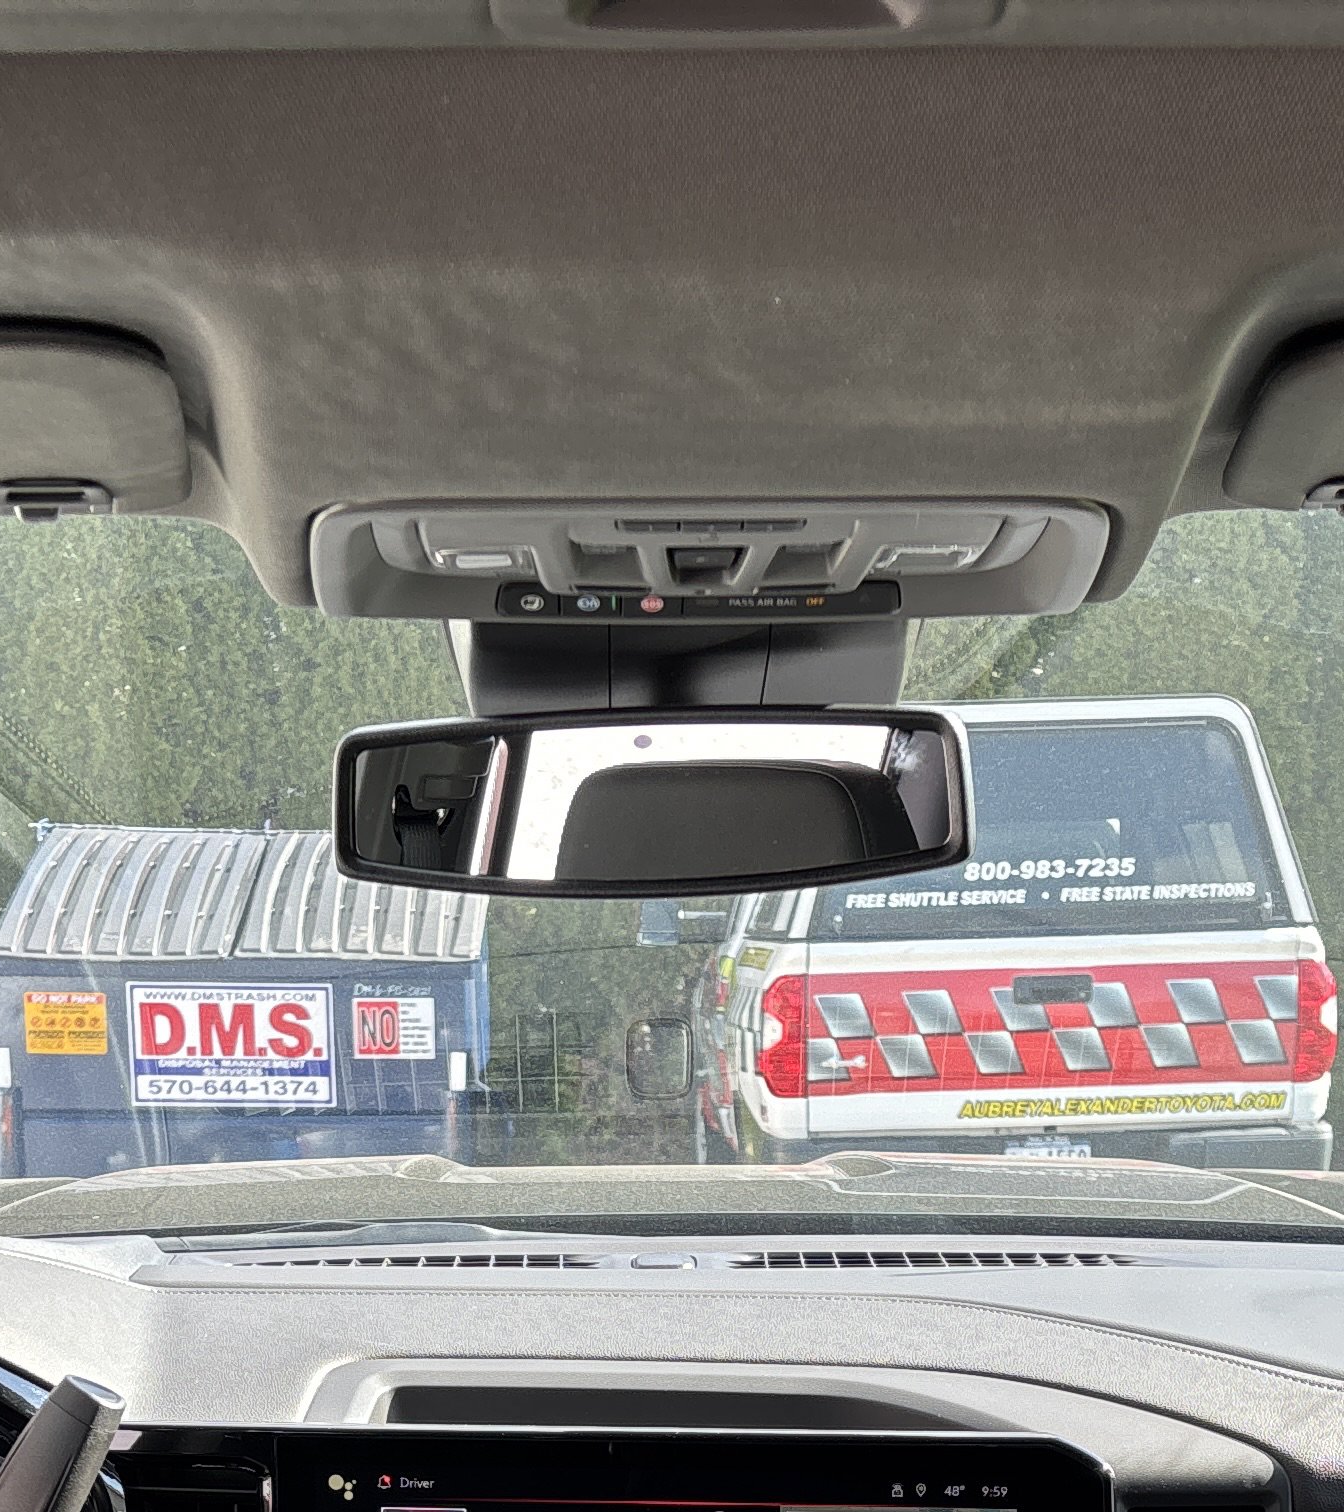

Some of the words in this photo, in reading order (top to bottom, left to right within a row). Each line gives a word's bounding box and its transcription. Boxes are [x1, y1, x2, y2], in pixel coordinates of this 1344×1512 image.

[963, 857, 1136, 881] 800-983-7235
[845, 893, 886, 908] FREE
[887, 891, 959, 907] SHUTTLE
[959, 889, 1027, 905] SERVICE
[1059, 887, 1101, 902] FREE
[1102, 885, 1151, 901] STATE
[1153, 881, 1256, 899] INSPECTIONS
[144, 991, 317, 1002] WWW.DMSTRASH.COM
[139, 1002, 323, 1058] D.M.S.
[359, 1006, 398, 1050] NO
[148, 1079, 319, 1096] 570-644-1374
[958, 1091, 1289, 1119] AUBREYALEXANDERTOYOTA.COM
[400, 1477, 435, 1488] Driver
[981, 1485, 1008, 1498] 9:59
